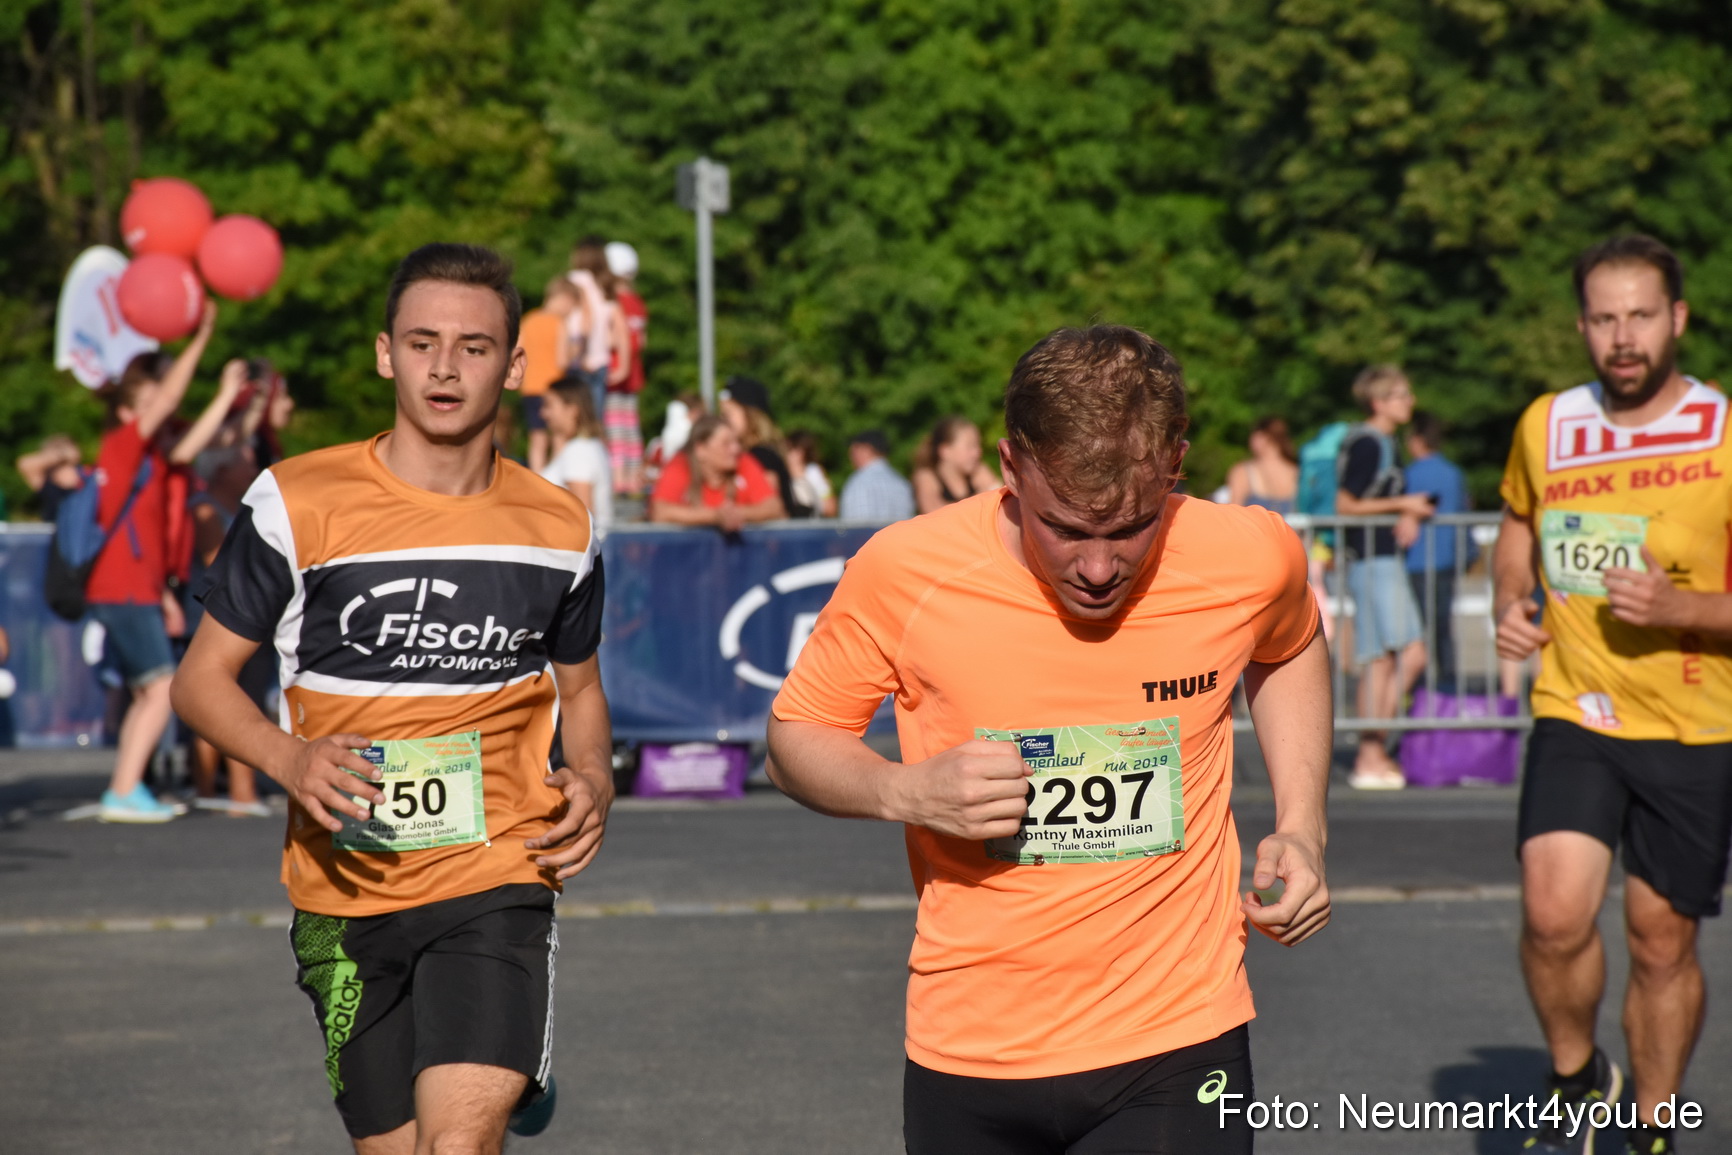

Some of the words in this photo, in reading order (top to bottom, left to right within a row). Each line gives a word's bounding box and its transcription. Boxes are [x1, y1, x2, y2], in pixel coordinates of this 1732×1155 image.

[1543, 472, 1616, 504] MAX
[1629, 459, 1722, 490] BÖGL
[1555, 541, 1629, 571] 1620
[1141, 670, 1218, 702] THULE
[445, 762, 471, 774] 2019
[1025, 752, 1086, 769] menlauf
[1133, 755, 1168, 770] 2019
[368, 821, 406, 832] Glaser
[410, 819, 445, 831] Jonas
[386, 832, 431, 840] Automobile
[434, 827, 458, 836] GmbH
[1013, 829, 1067, 842] Kontny
[1072, 824, 1153, 839] Maximilian
[1052, 842, 1080, 851] Thule
[1083, 841, 1115, 850] GmbH
